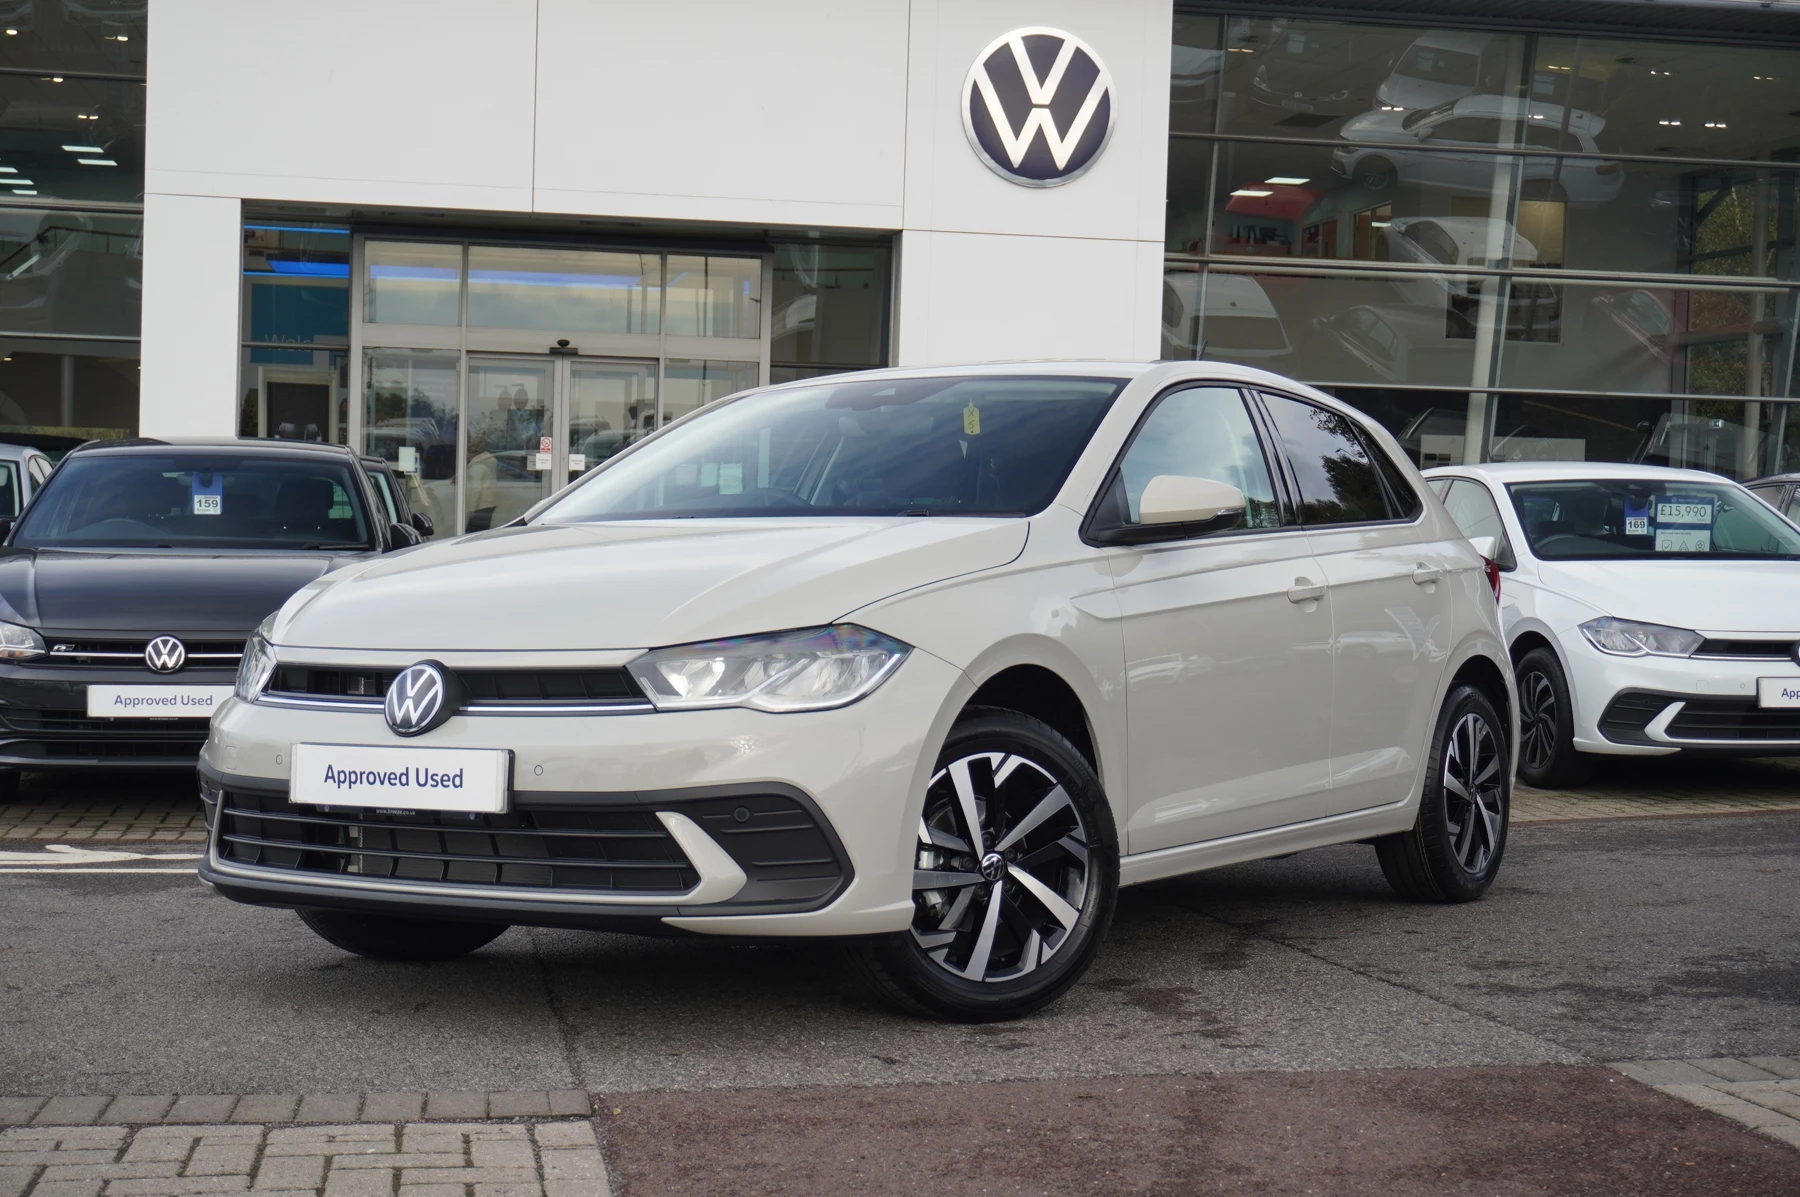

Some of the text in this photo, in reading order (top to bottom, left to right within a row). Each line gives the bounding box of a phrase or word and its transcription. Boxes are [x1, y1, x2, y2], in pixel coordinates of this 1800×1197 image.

[966, 31, 1113, 175] VW
[197, 499, 218, 508] 159
[1660, 505, 1707, 518] £15,990
[1627, 521, 1645, 529] 169
[114, 694, 213, 708] Approved Used
[386, 664, 443, 730] VW
[324, 764, 464, 789] Approved Used
